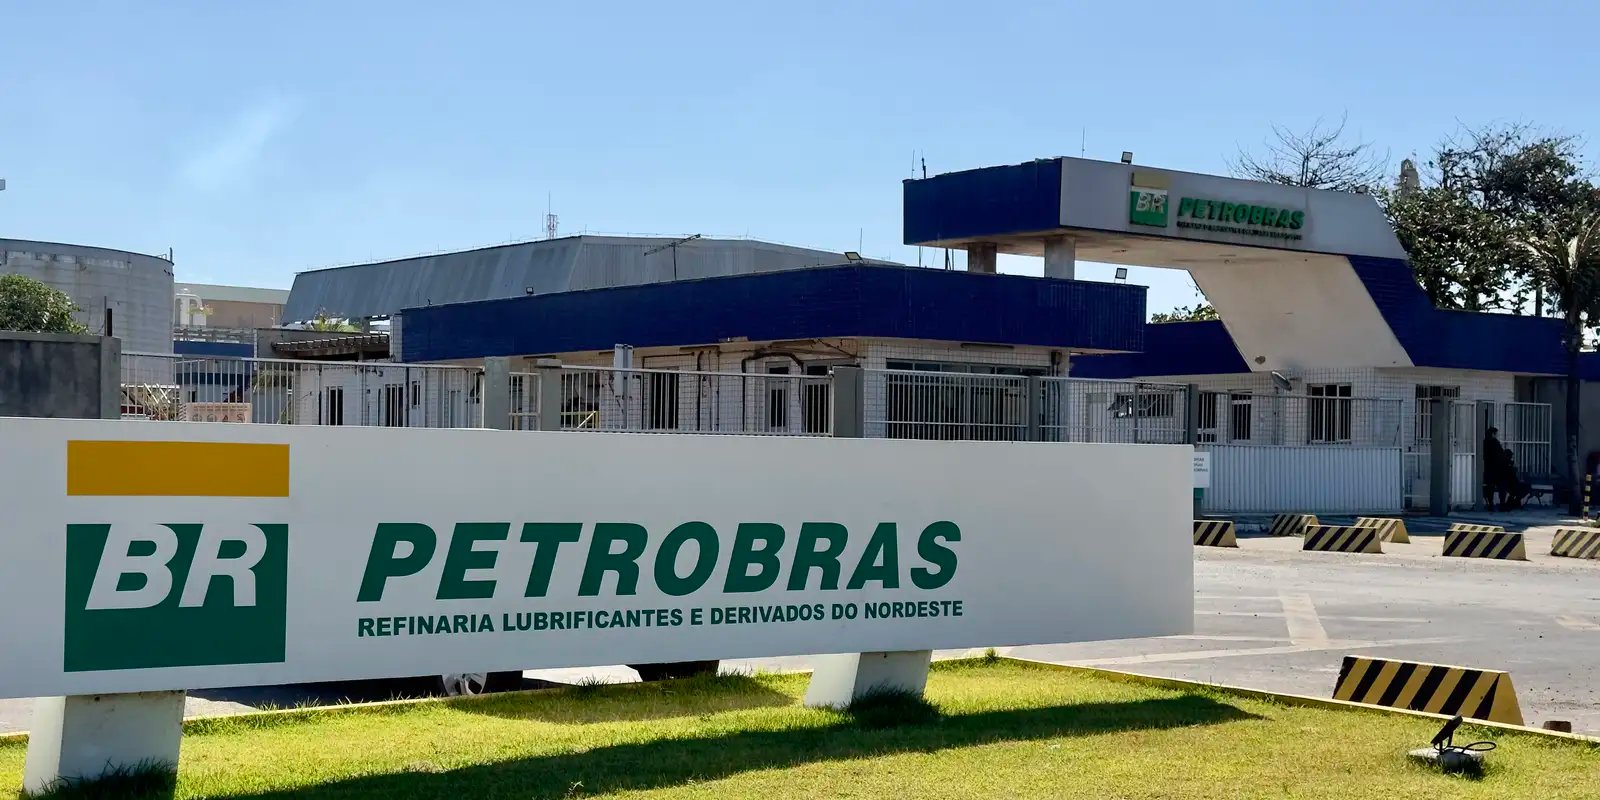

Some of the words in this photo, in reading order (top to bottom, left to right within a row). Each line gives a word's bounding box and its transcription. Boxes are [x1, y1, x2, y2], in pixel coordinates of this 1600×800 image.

[1136, 191, 1166, 214] BR
[1177, 197, 1305, 230] PETROBRAS
[85, 523, 268, 610] BR
[357, 521, 962, 603] PETROBRAS
[358, 614, 495, 637] REFINARIA
[503, 609, 684, 632] LUBRIFICANTES
[690, 608, 704, 625] E
[711, 604, 826, 625] DERIVADOS
[832, 603, 859, 620] DO
[865, 601, 964, 619] NORDESTE
